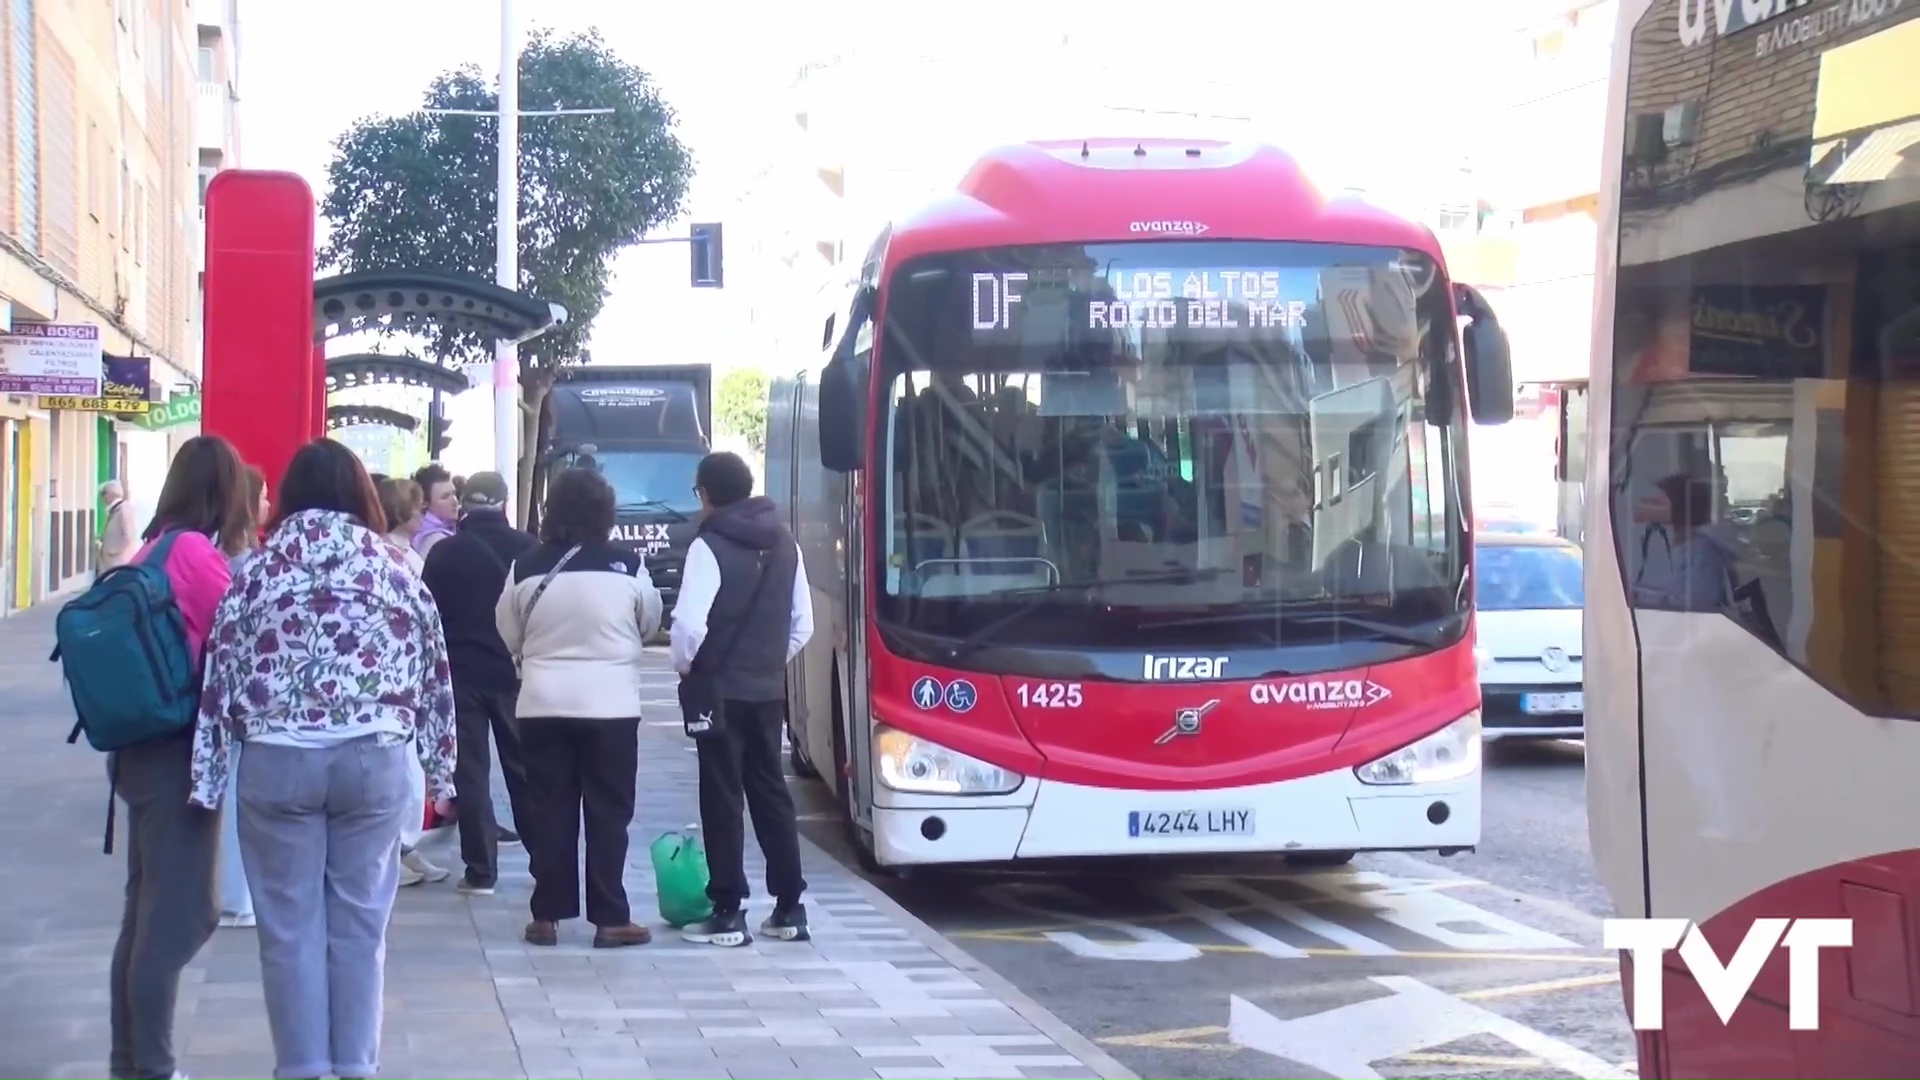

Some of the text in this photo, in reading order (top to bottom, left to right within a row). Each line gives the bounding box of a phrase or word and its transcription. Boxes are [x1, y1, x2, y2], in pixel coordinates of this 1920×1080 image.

[1130, 220, 1194, 233] avanza
[1116, 271, 1279, 299] LOS ALTOS
[972, 272, 1029, 330] DF
[1089, 301, 1307, 329] ROCIO DEL MAR
[47, 327, 95, 339] BOSCH
[81, 399, 108, 409] 688
[1143, 655, 1229, 679] Irizar
[1017, 683, 1082, 708] 1425
[1250, 680, 1362, 704] avanza
[1144, 811, 1249, 833] 4244 LHY
